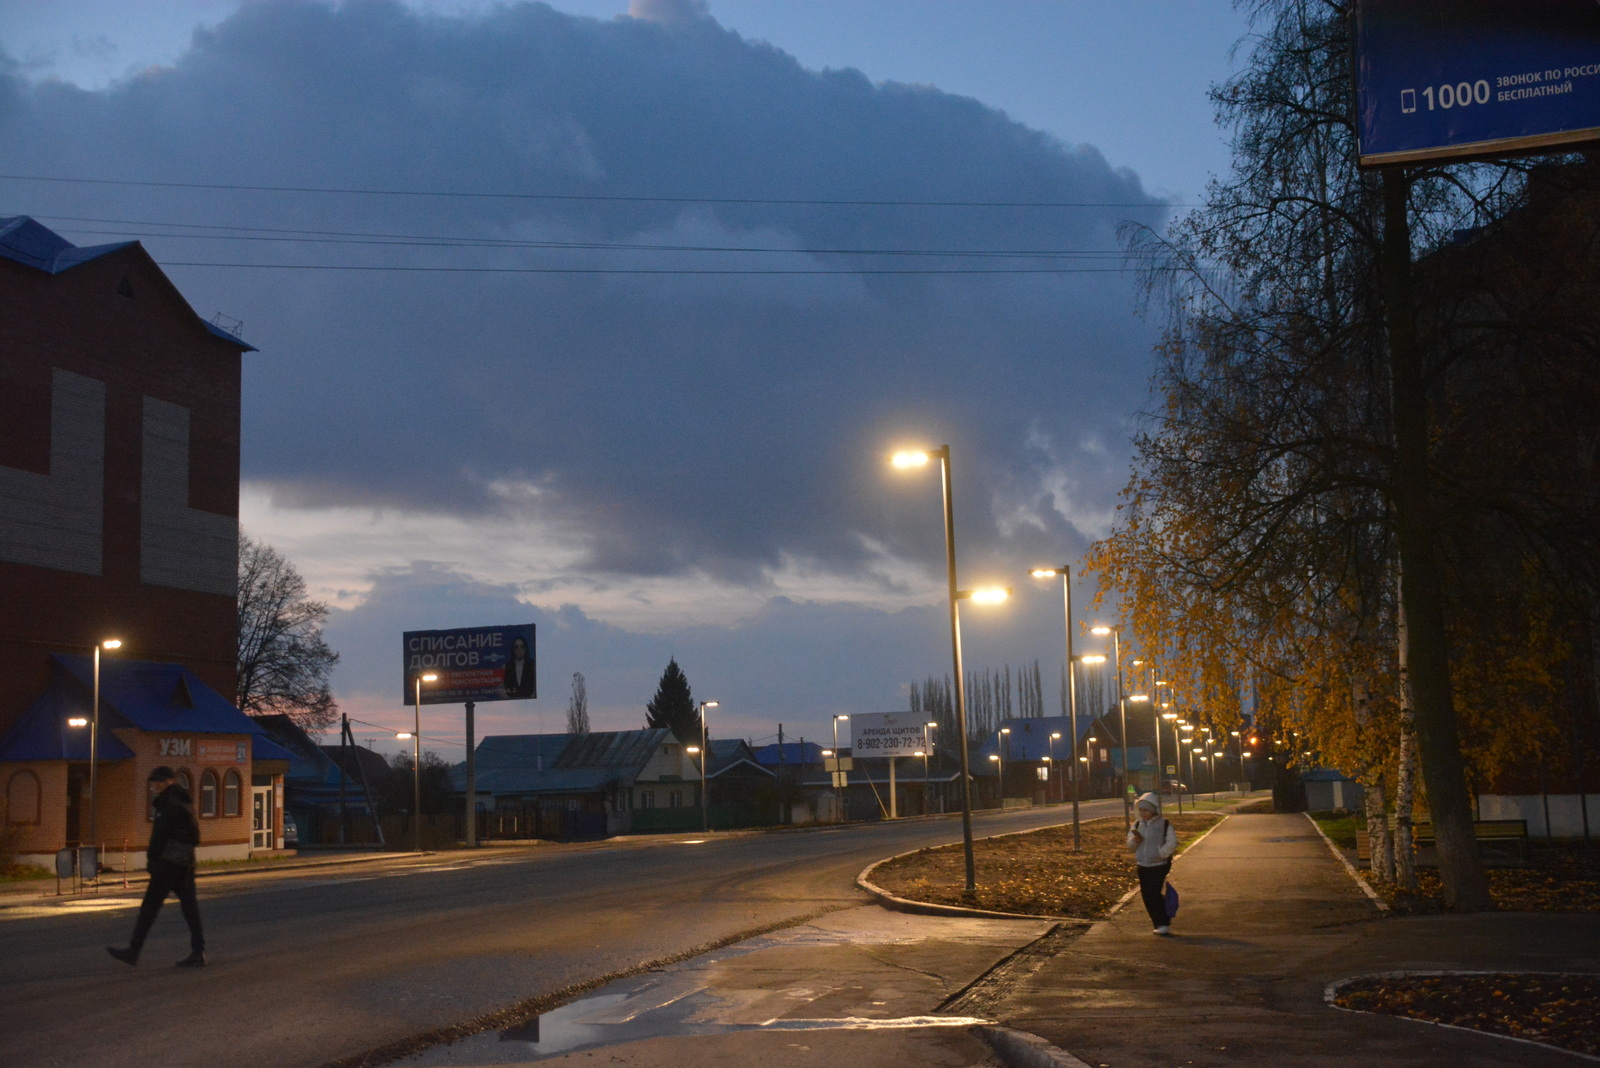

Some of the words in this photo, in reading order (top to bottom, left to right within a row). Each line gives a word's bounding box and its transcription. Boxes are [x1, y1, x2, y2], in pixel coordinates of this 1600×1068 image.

[1496, 72, 1542, 88] ЗВОНОК
[1544, 69, 1561, 81] ПО
[1423, 80, 1490, 110] 1000
[1497, 81, 1572, 101] БЕСПЛАТНЫЙ
[409, 633, 503, 651] СПИСАНИЕ
[409, 652, 479, 670] ДОЛГОВ
[863, 728, 891, 736] АРЕНДА
[892, 727, 921, 735] ЩИТОВ
[159, 738, 191, 756] УЗИ
[237, 747, 246, 758] 21
[858, 738, 926, 750] 8-902-230-72-72
